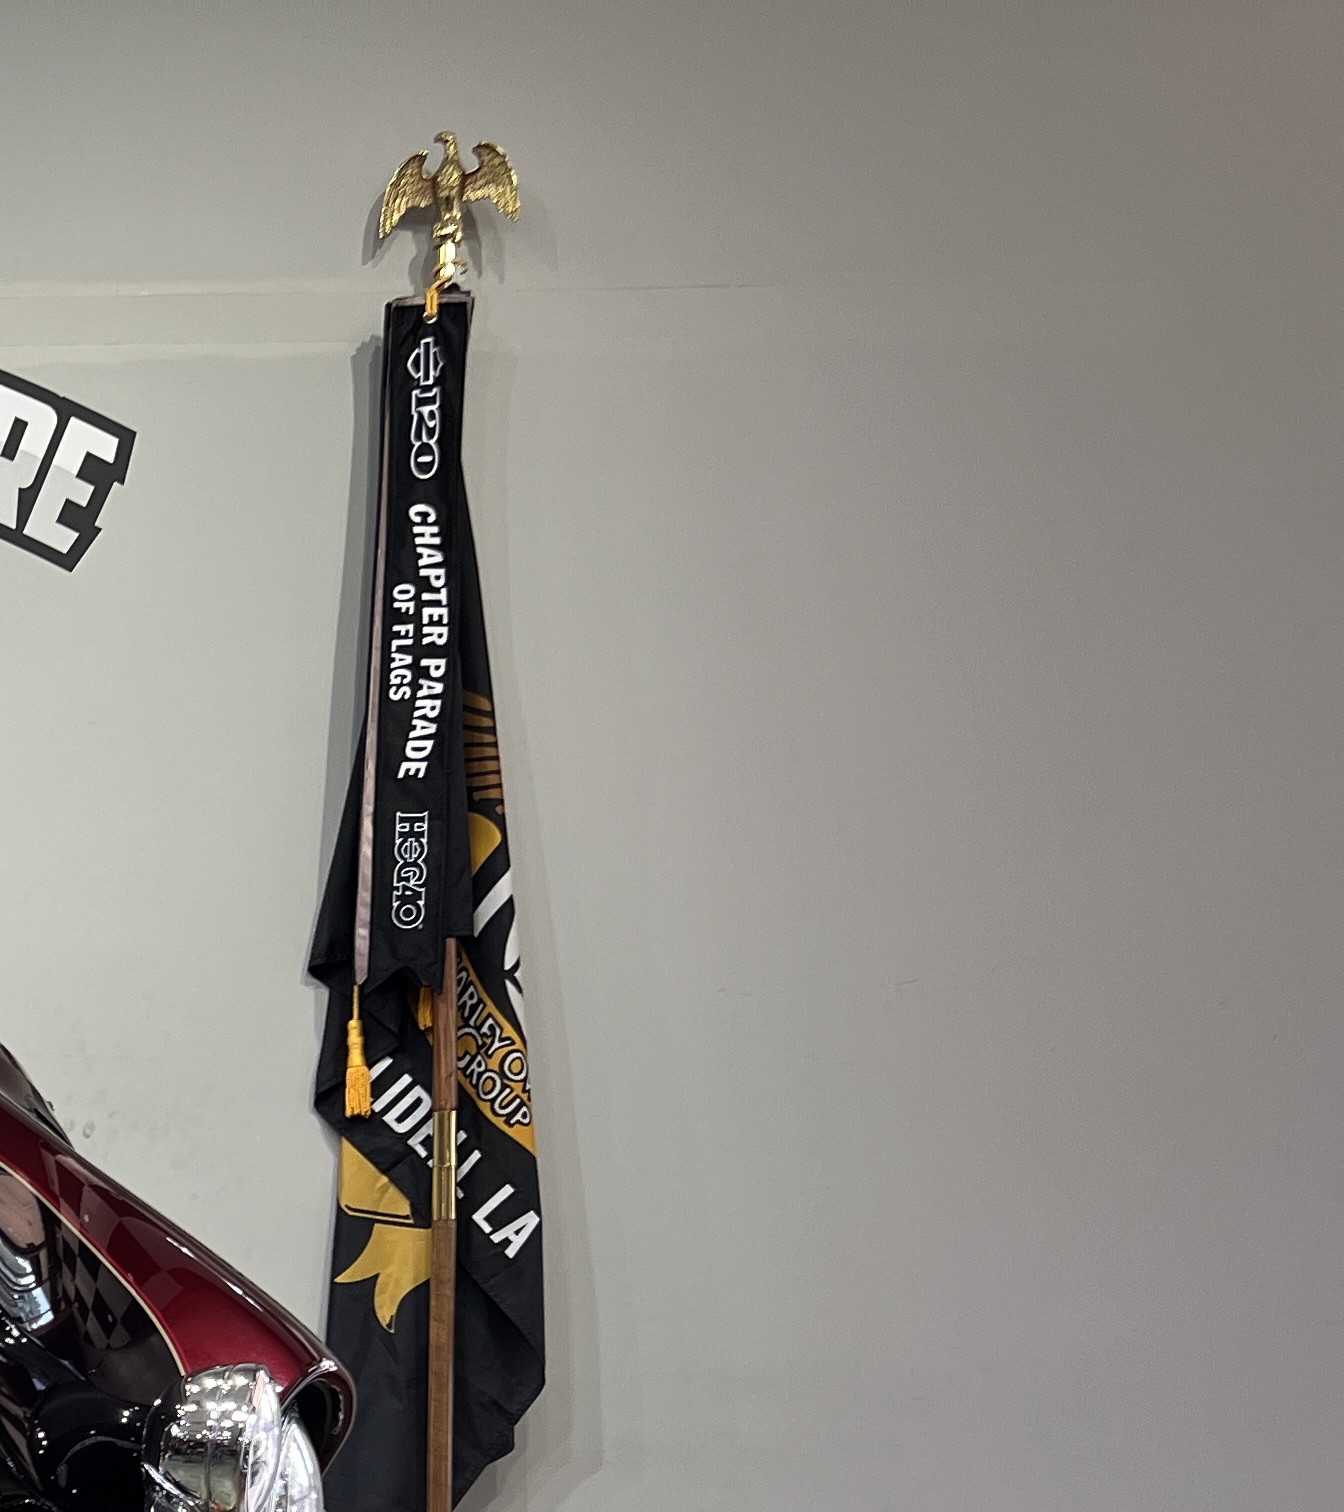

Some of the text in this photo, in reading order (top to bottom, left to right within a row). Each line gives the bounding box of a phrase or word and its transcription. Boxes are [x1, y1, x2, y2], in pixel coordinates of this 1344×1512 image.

[387, 582, 416, 702] OF FLAGS
[395, 503, 450, 781] CHAPTER PARADE
[456, 1026, 532, 1125] GROUP
[470, 1183, 541, 1260] LA
